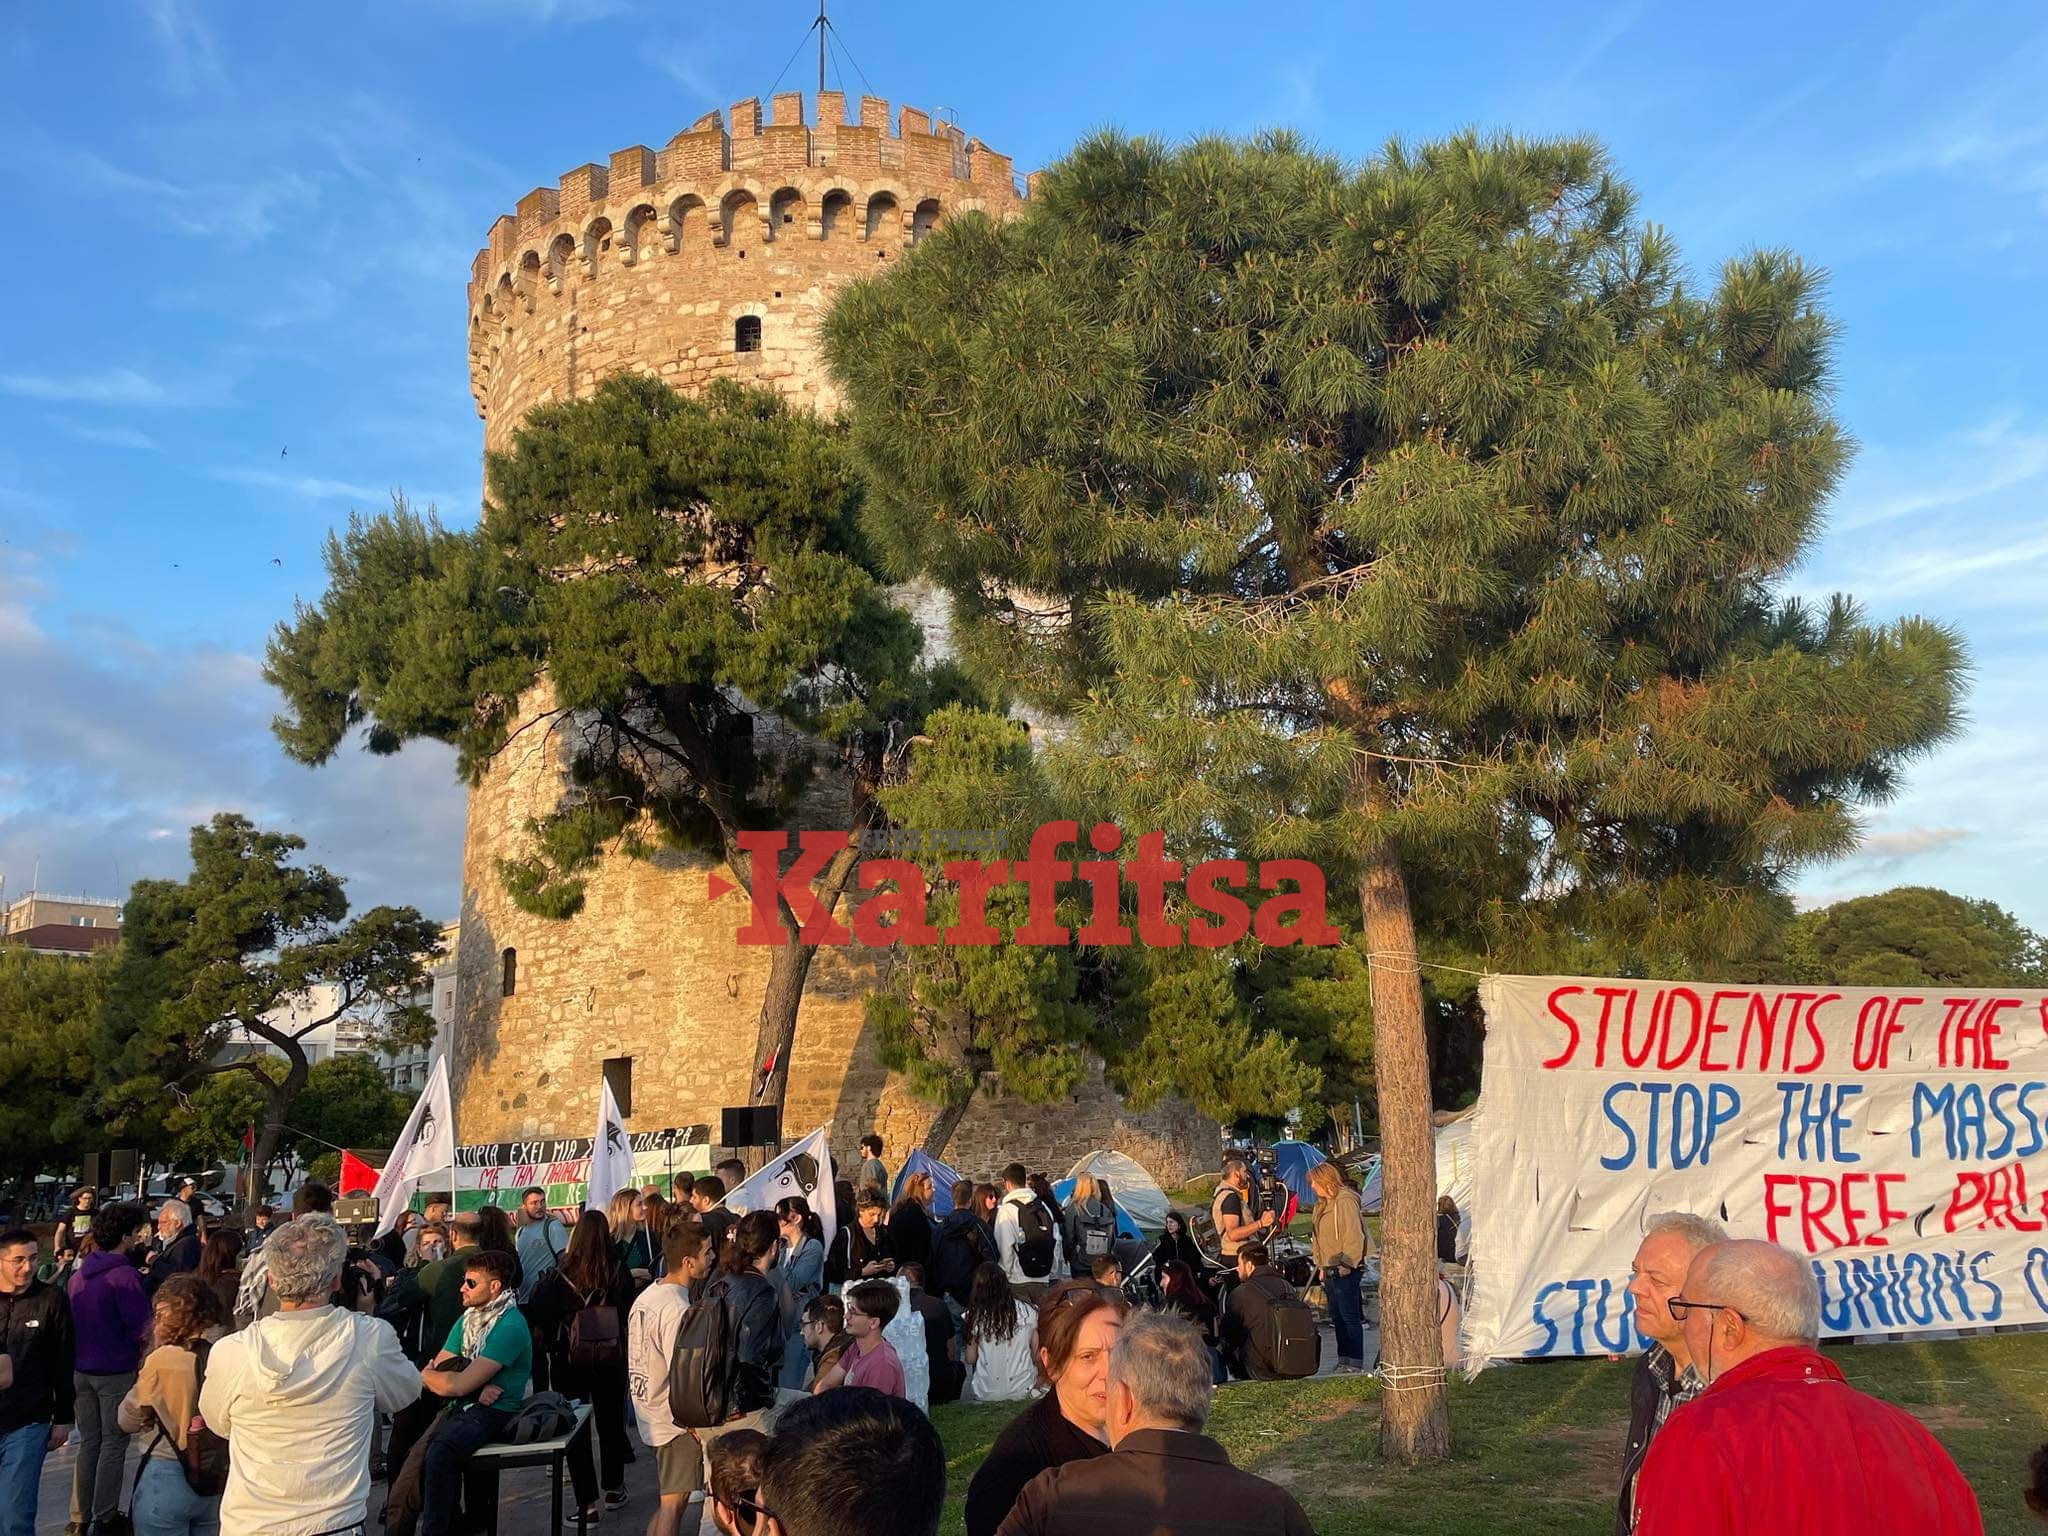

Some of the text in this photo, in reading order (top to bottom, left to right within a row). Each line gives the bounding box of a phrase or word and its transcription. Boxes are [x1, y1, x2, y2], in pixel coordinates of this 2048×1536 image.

[1542, 985, 1843, 1074] STUDENTS
[1852, 995, 1925, 1072] OF
[1938, 997, 2024, 1070] THE
[454, 1144, 500, 1168] ΣΤΟΡΙΑ
[509, 1141, 545, 1165] ΕΧΕΙ
[552, 1139, 578, 1163] ΜΙΑ
[1600, 1081, 2048, 1171] STOP THE MASS
[478, 1167, 503, 1189] ΜΕ
[511, 1165, 539, 1188] ΤΗΝ
[1764, 1162, 2048, 1253] FREE PAL
[1523, 1273, 1655, 1356] STU
[1811, 1250, 2004, 1331] UNIONS
